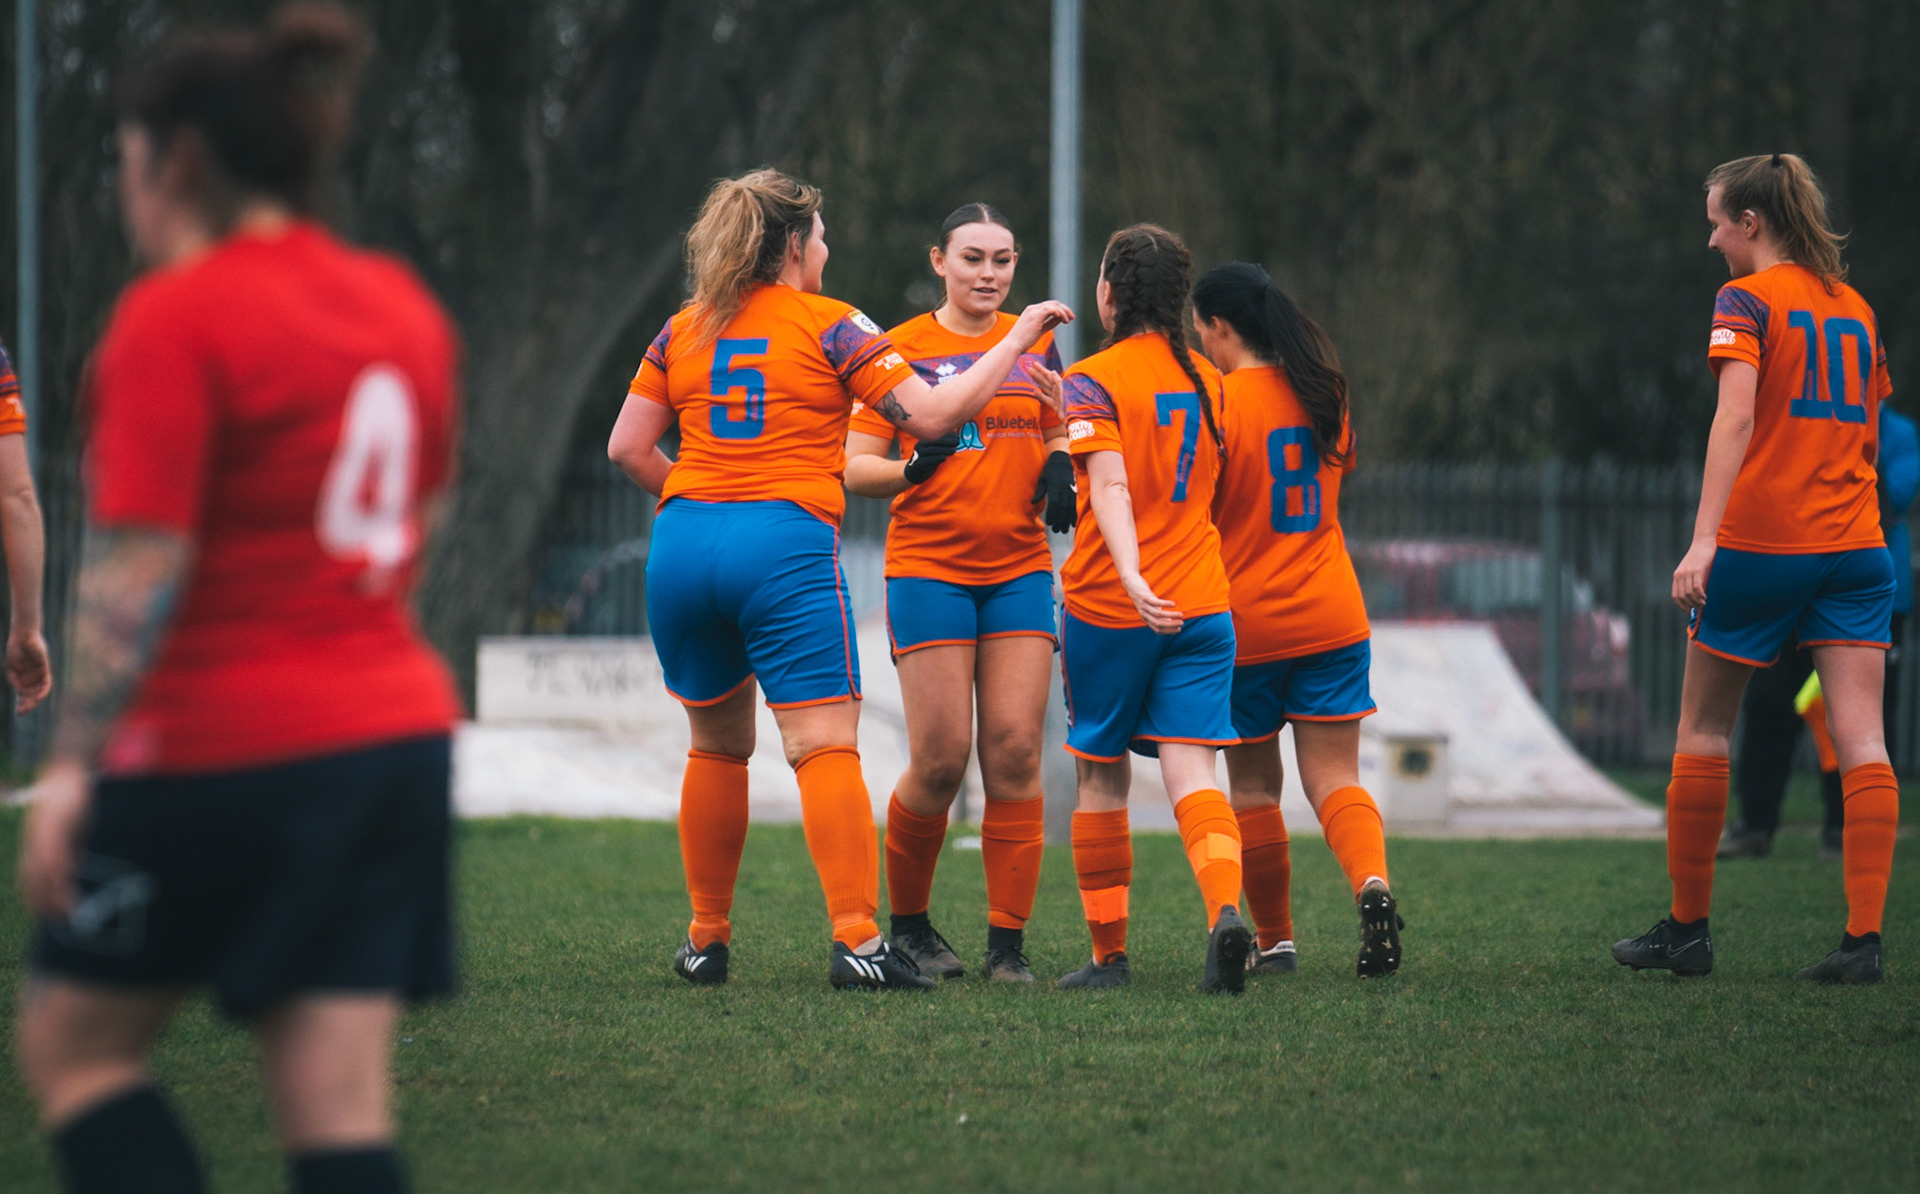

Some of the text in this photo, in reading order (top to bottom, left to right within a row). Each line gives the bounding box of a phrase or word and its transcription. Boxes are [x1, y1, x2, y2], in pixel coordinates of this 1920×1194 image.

[709, 338, 769, 439] 5
[1787, 310, 1873, 425] 10
[314, 362, 417, 592] 4
[1155, 391, 1202, 502] 7
[1267, 426, 1321, 534] 8
